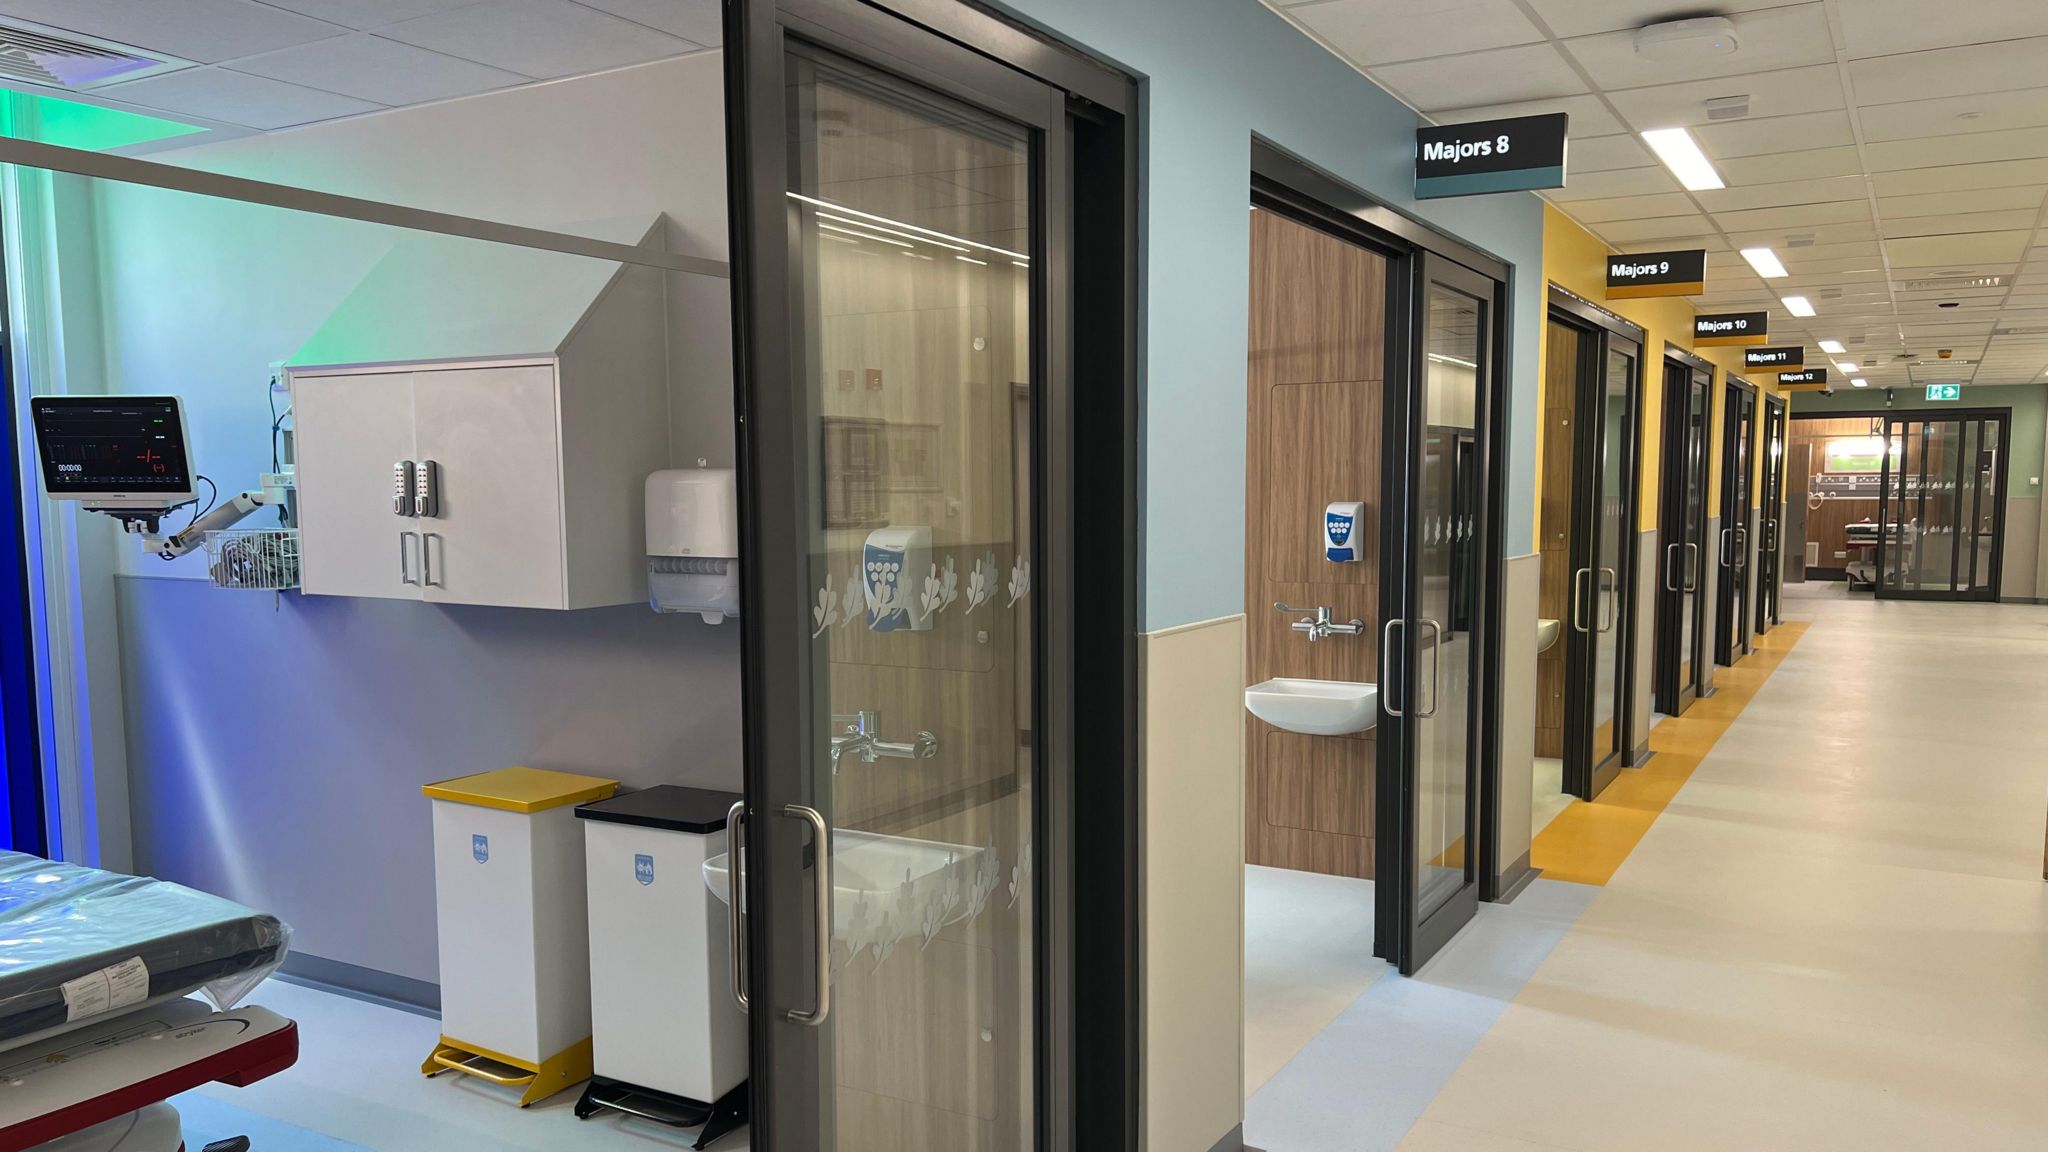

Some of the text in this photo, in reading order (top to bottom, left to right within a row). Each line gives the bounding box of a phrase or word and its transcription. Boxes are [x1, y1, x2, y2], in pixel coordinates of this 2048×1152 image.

[1423, 135, 1509, 163] Majors 8
[1611, 261, 1670, 279] Majors 9
[1697, 319, 1747, 333] Majors 10
[1747, 352, 1787, 363] Majors 11
[1780, 373, 1804, 382] Majors
